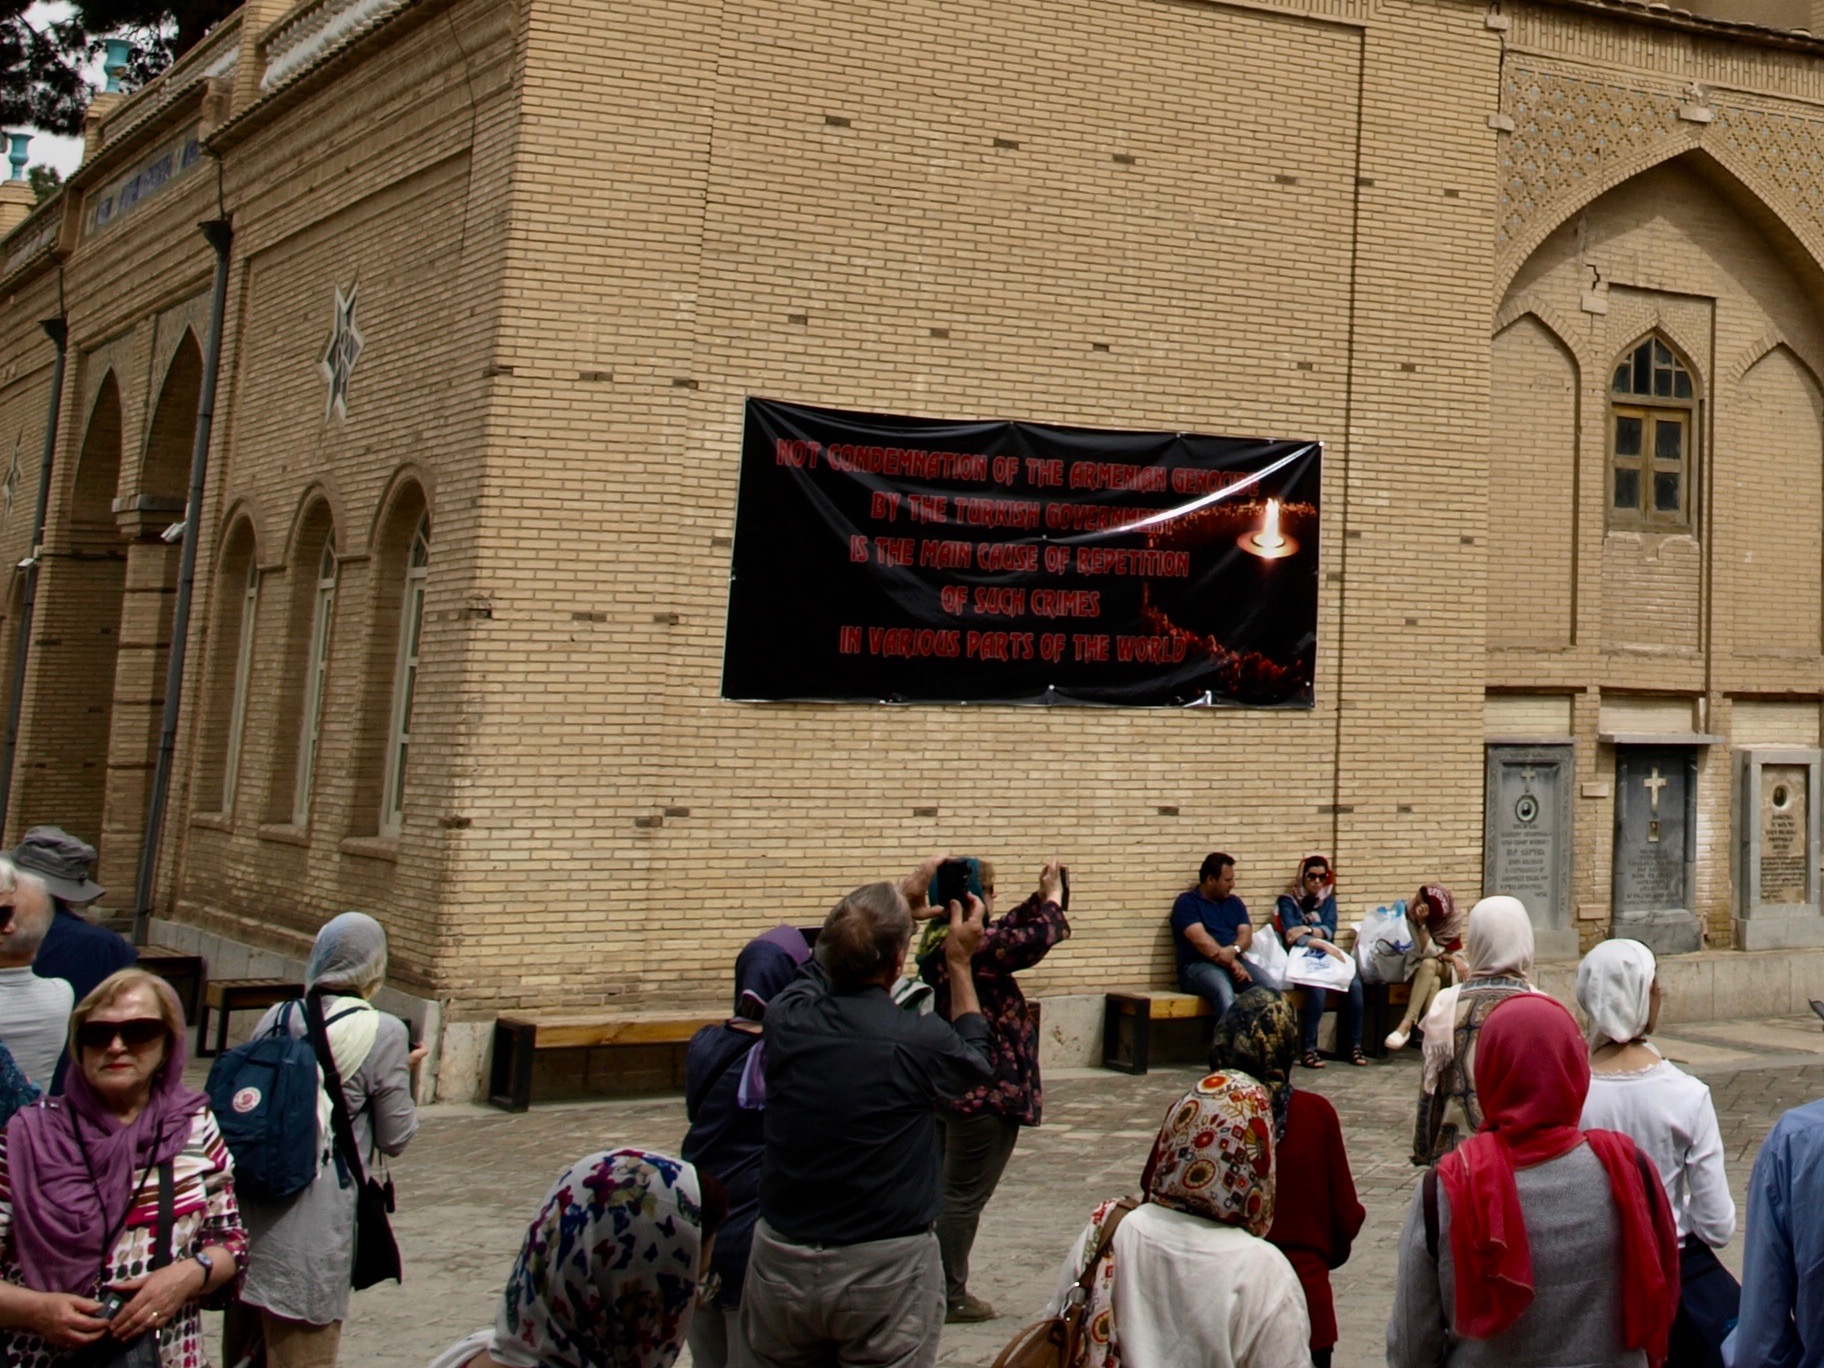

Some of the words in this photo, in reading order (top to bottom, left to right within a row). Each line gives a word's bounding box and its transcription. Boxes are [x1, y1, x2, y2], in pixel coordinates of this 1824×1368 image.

[776, 438, 821, 468] NOT
[827, 444, 987, 482] CONDEMNATION
[992, 456, 1019, 486] OF
[1025, 458, 1064, 488] THE
[1069, 461, 1166, 492] ARMENIAN
[1171, 467, 1260, 497] GENOCIDE
[871, 491, 901, 522] BY
[907, 495, 947, 524] THE
[954, 496, 1040, 530] TURKISH
[850, 534, 868, 562] IS
[874, 537, 915, 567] THE
[920, 539, 972, 569] MAIN
[977, 542, 1038, 572] CAUSE
[1044, 546, 1071, 575] OF
[1077, 547, 1189, 578] REPETITION
[941, 585, 969, 616] OF
[974, 587, 1025, 617] SUCH
[1031, 589, 1100, 619] CRIMES
[839, 625, 862, 653] IN
[868, 627, 960, 658] VARIOUS
[966, 630, 1034, 661] PARTS
[1040, 633, 1066, 663] OF
[1072, 634, 1110, 663] THE
[1116, 635, 1187, 665] WORLD
